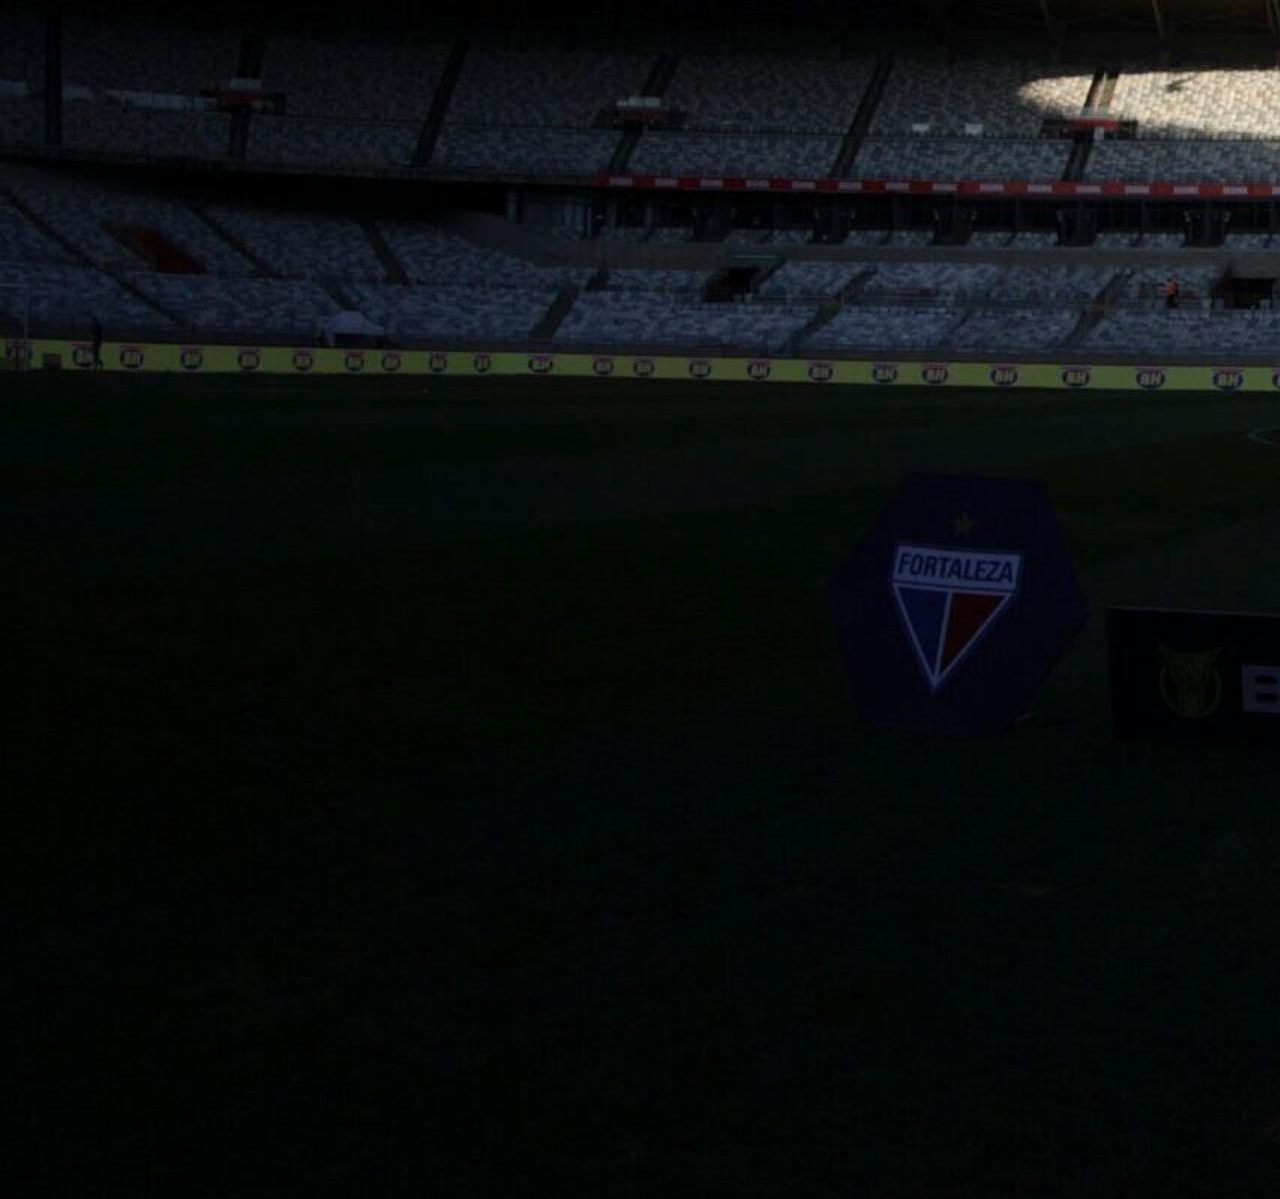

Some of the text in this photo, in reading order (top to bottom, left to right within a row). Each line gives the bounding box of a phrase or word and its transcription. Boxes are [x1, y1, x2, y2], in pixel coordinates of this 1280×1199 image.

[1142, 371, 1160, 384] BH
[1219, 372, 1237, 385] BH
[898, 553, 1013, 583] FORTALEZA
